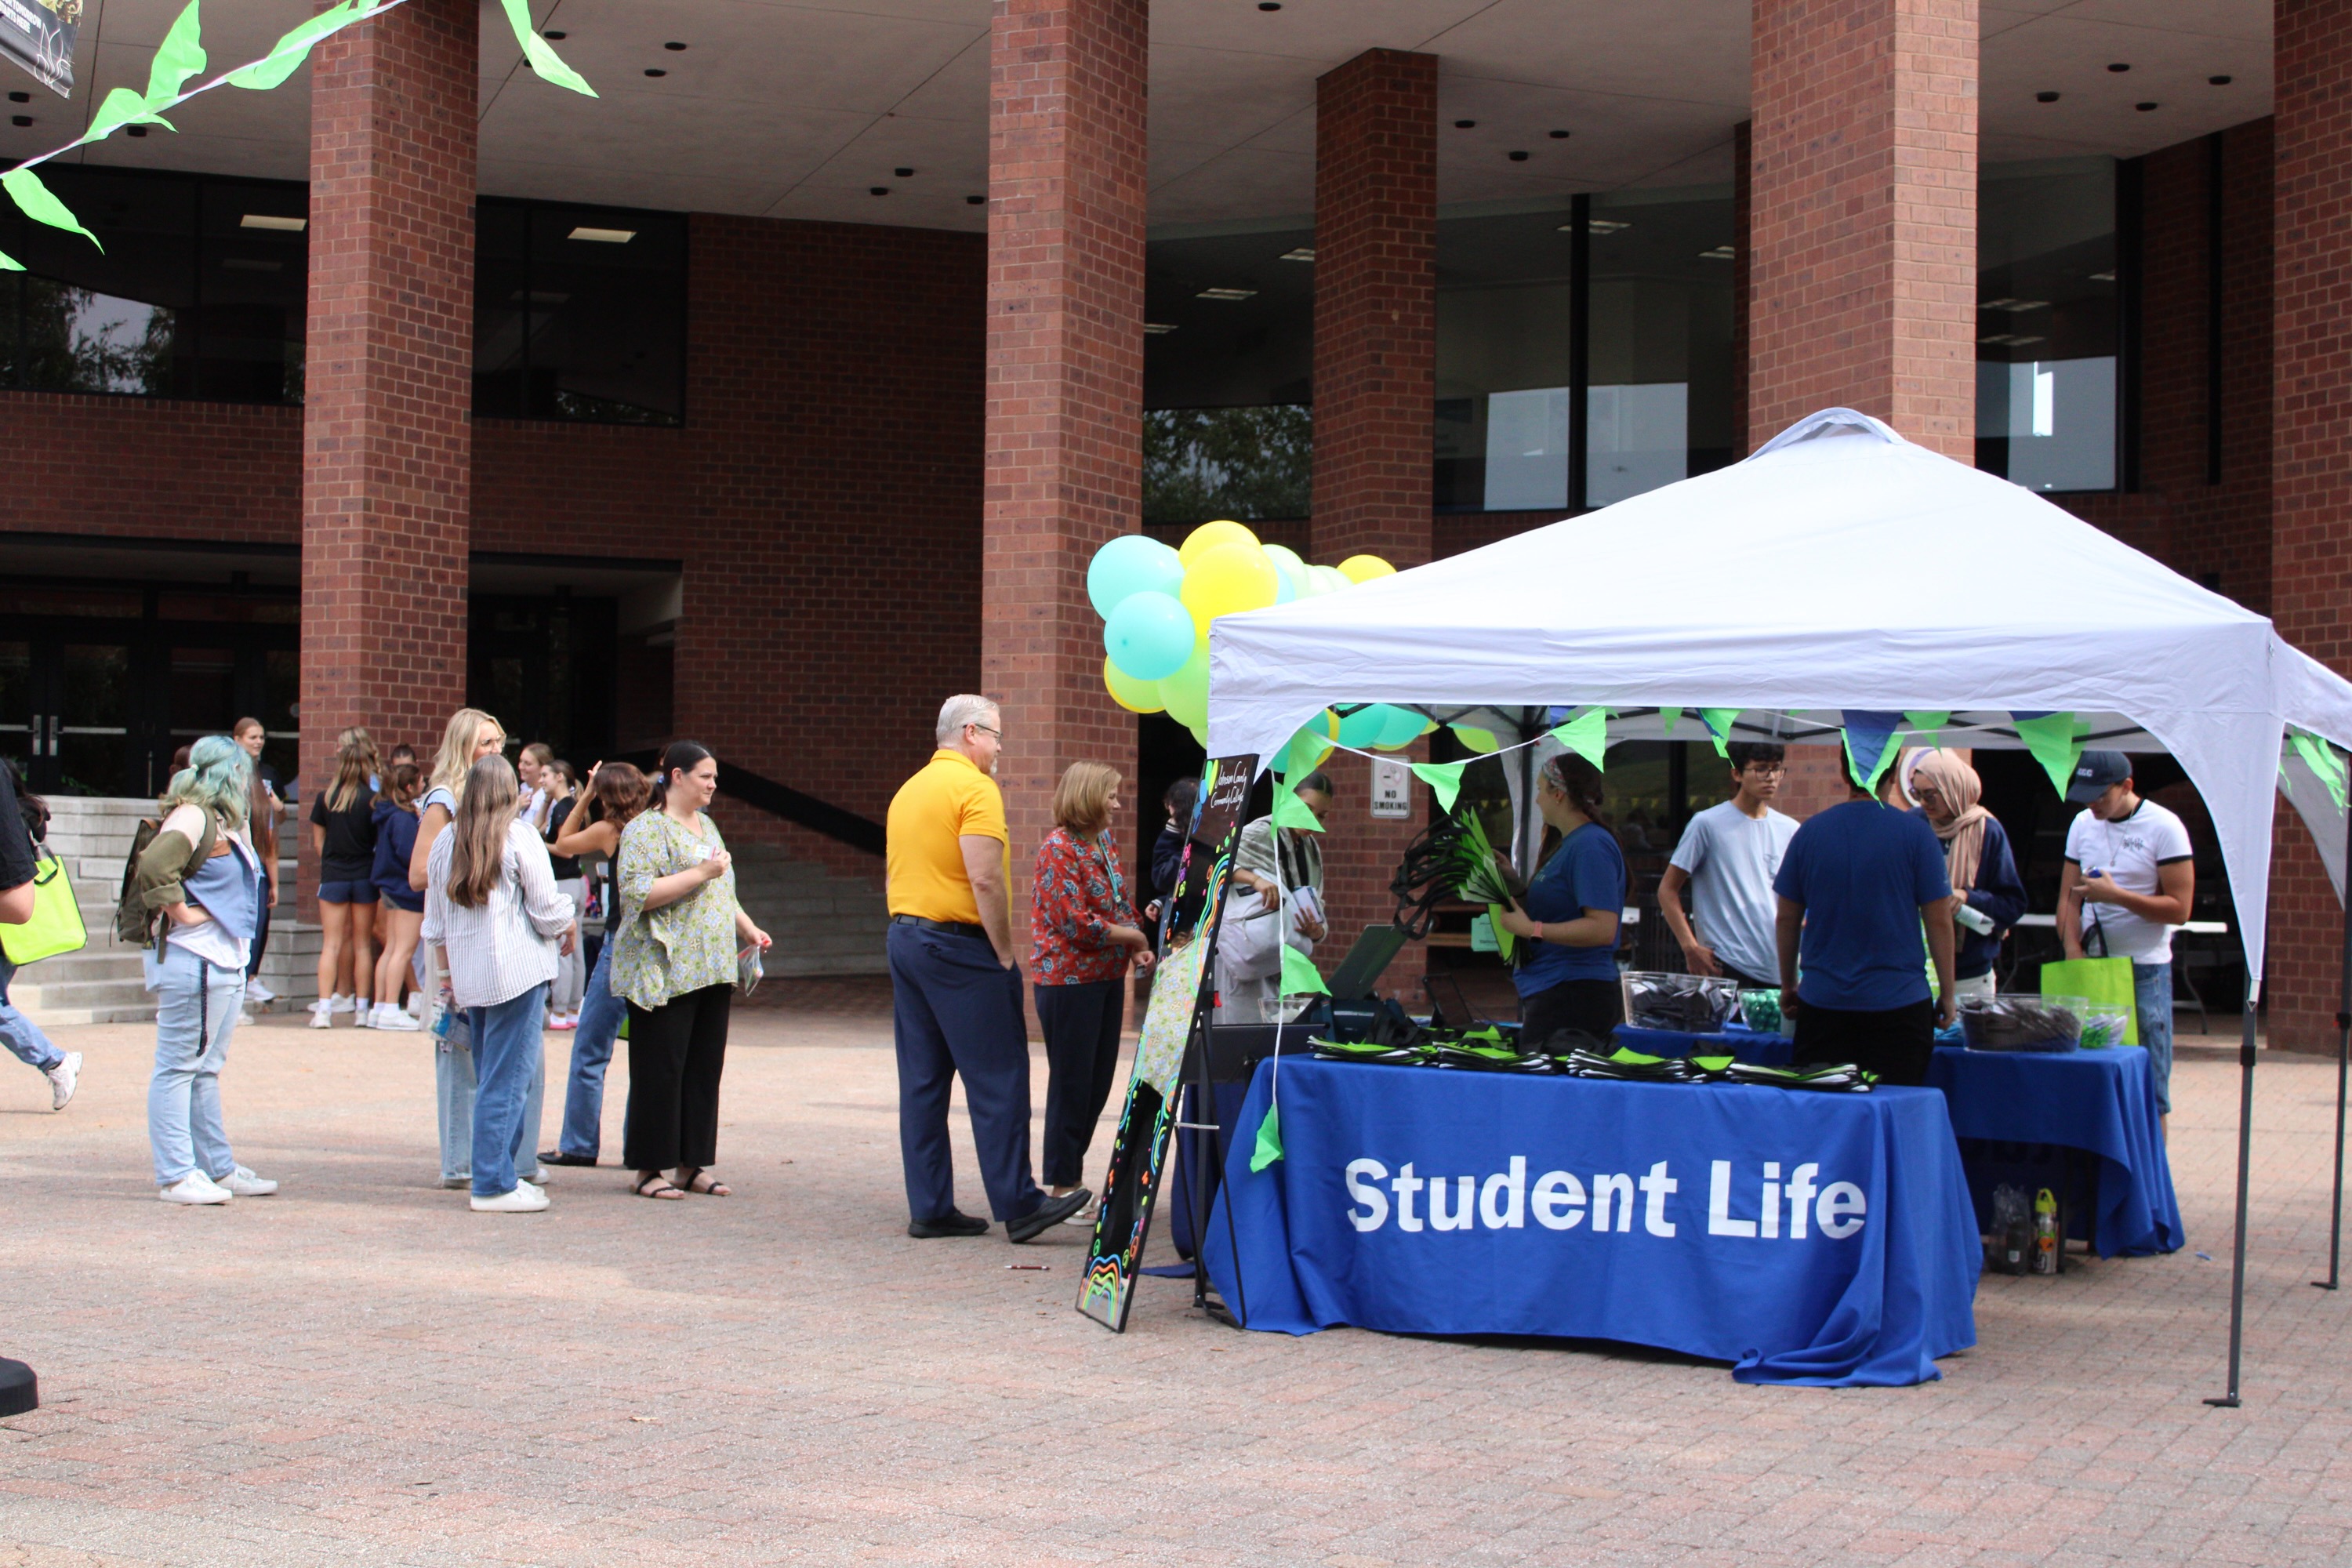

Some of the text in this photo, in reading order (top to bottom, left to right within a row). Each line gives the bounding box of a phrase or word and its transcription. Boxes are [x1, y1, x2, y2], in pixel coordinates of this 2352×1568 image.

[1214, 760, 1247, 795] Johnson County
[1210, 786, 1244, 812] Community College
[1374, 801, 1407, 810] SMOKING
[1345, 1156, 1866, 1240] Student Life
